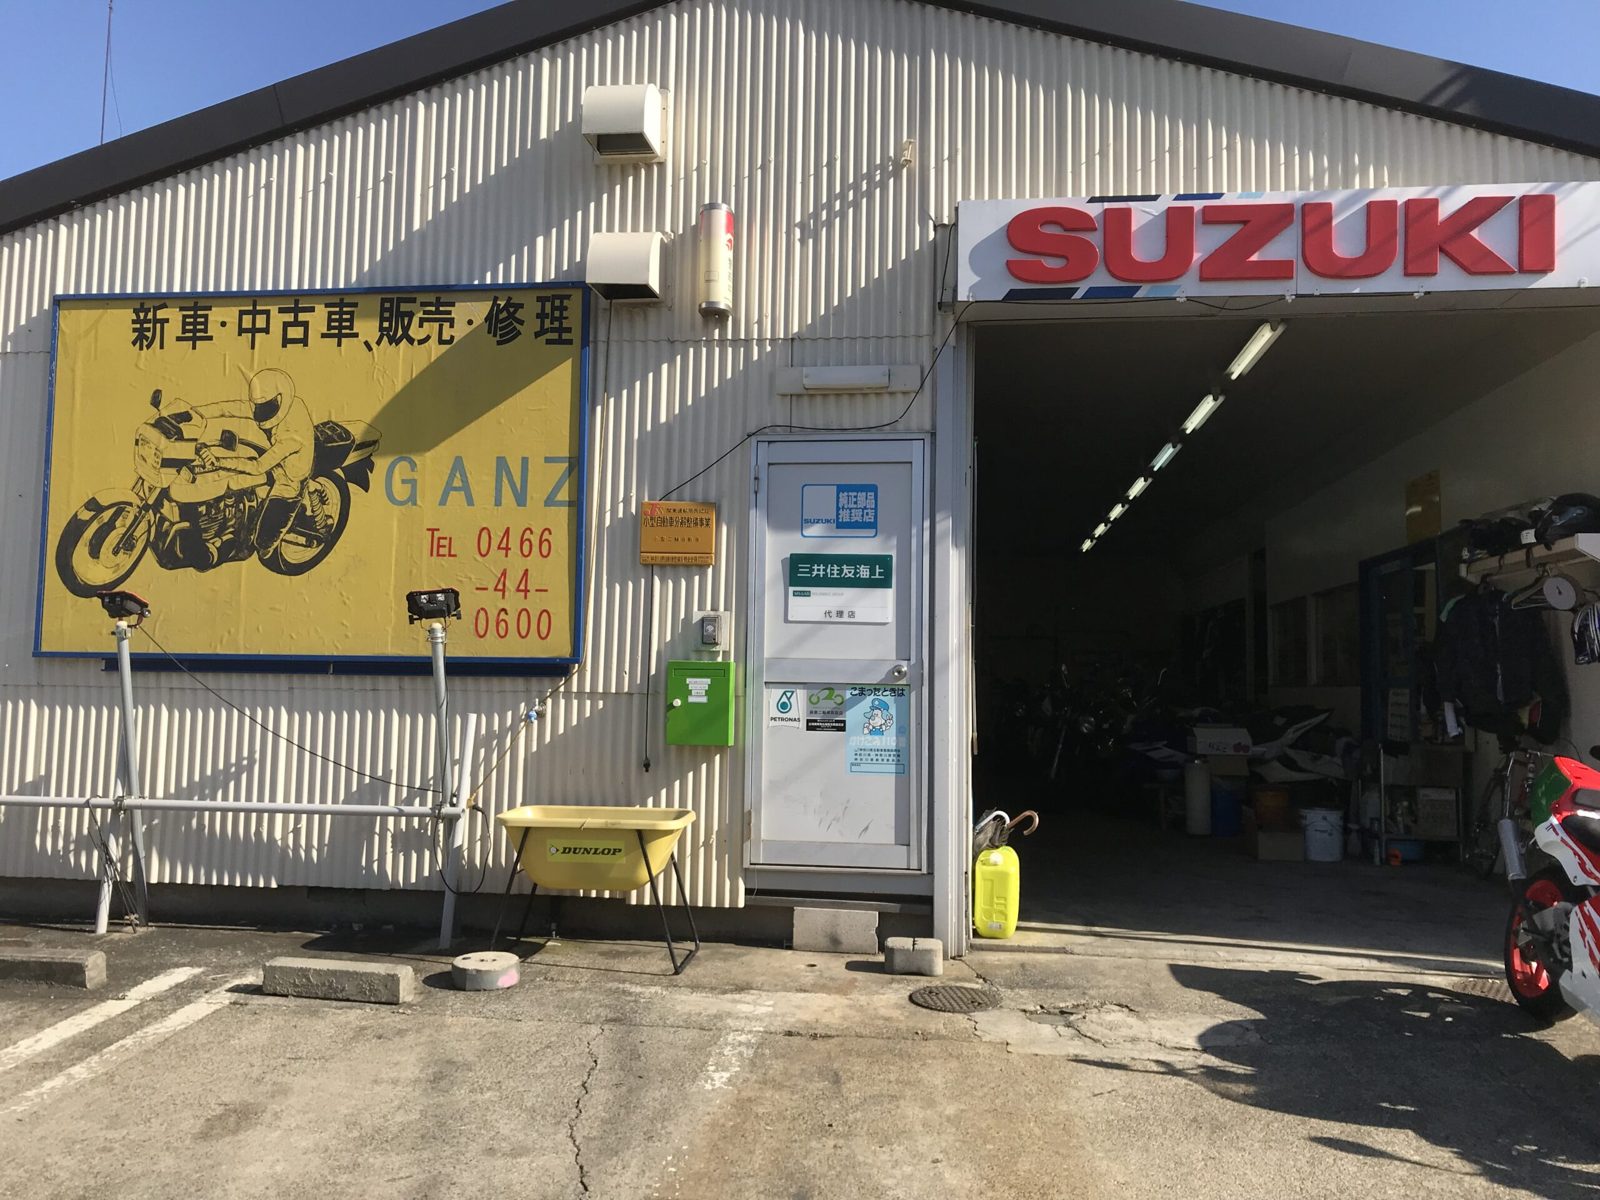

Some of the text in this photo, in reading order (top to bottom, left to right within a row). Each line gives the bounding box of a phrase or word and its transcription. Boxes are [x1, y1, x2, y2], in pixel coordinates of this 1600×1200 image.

[1005, 194, 1557, 284] SUZUKI
[384, 456, 577, 508] GANZ
[476, 526, 553, 559] 0466
[797, 563, 885, 579] 三井住友海上
[474, 607, 553, 641] 0600
[824, 610, 856, 619] 代理店
[849, 686, 906, 698] こまったときは
[560, 847, 622, 855] DUNLOP
